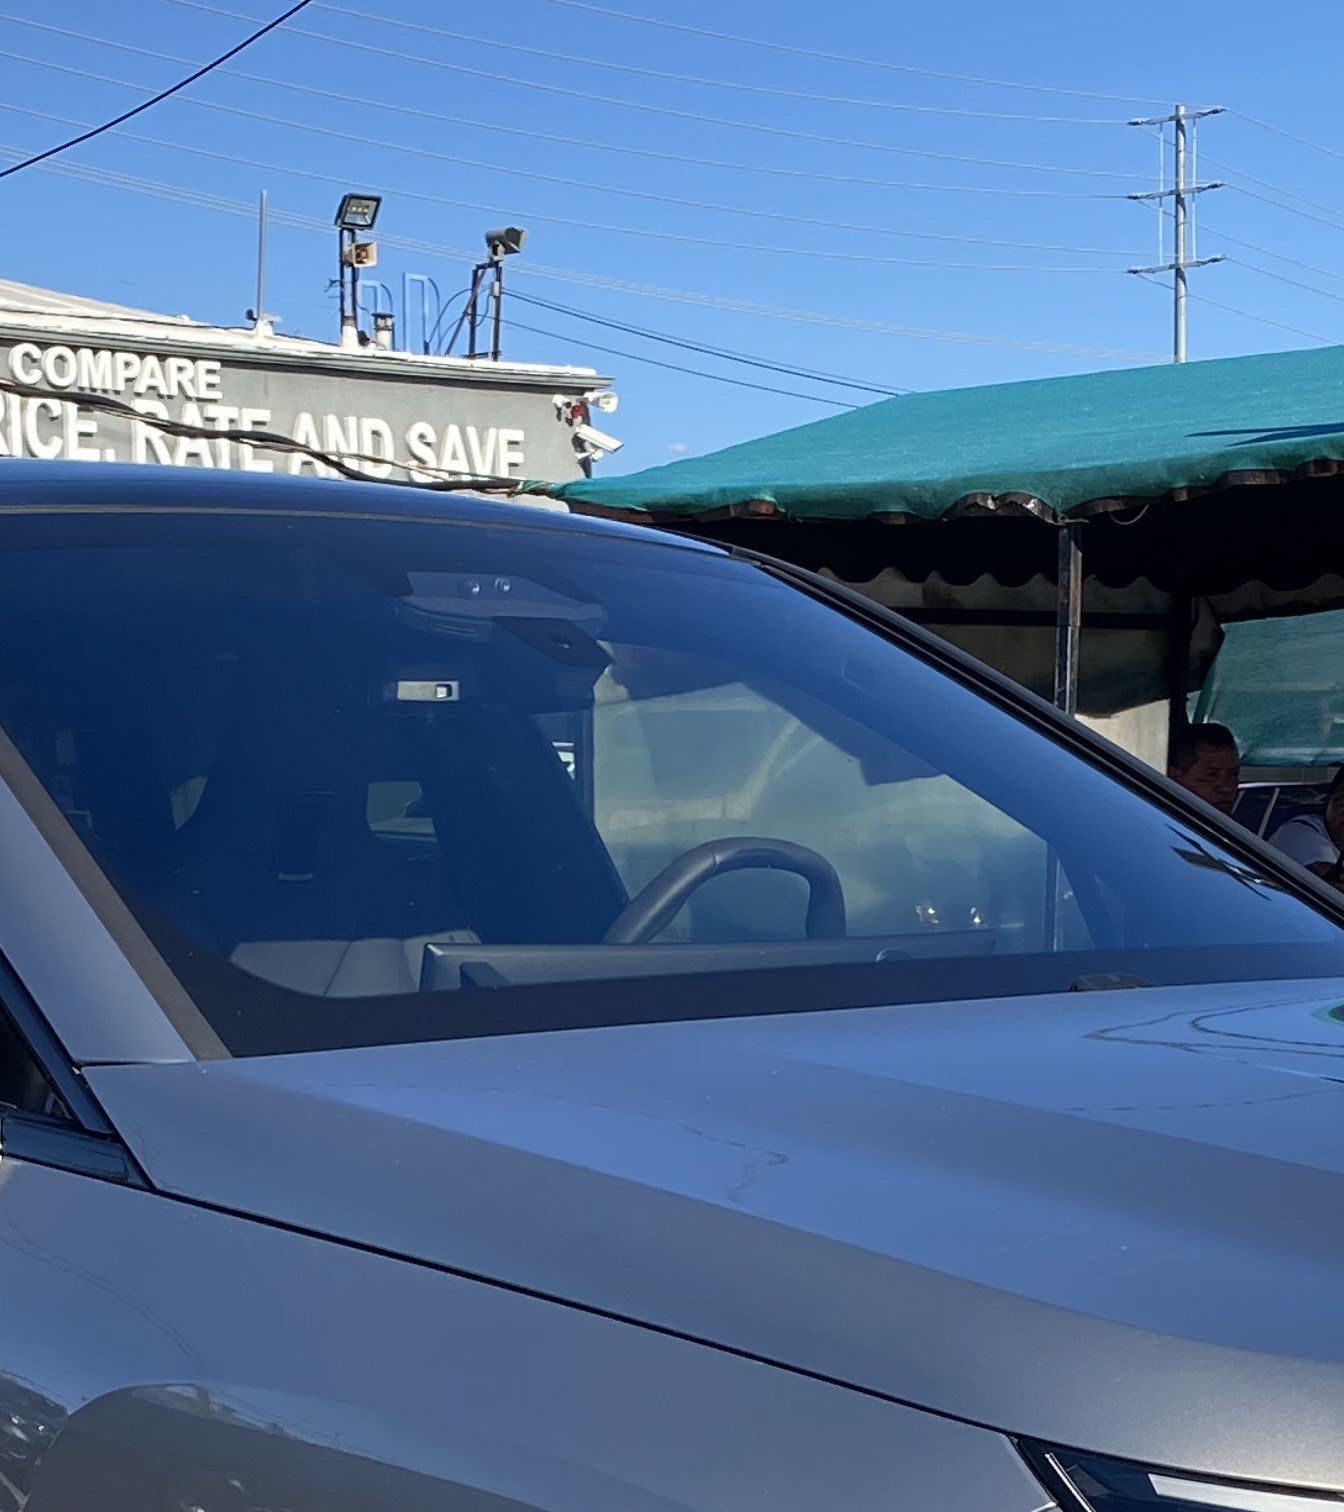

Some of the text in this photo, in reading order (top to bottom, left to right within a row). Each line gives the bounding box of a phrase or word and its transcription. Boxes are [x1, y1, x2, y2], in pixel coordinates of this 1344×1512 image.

[8, 343, 224, 400] COMPARE
[132, 396, 274, 474] RATE
[288, 412, 395, 481] AND
[405, 421, 525, 483] SAVE
